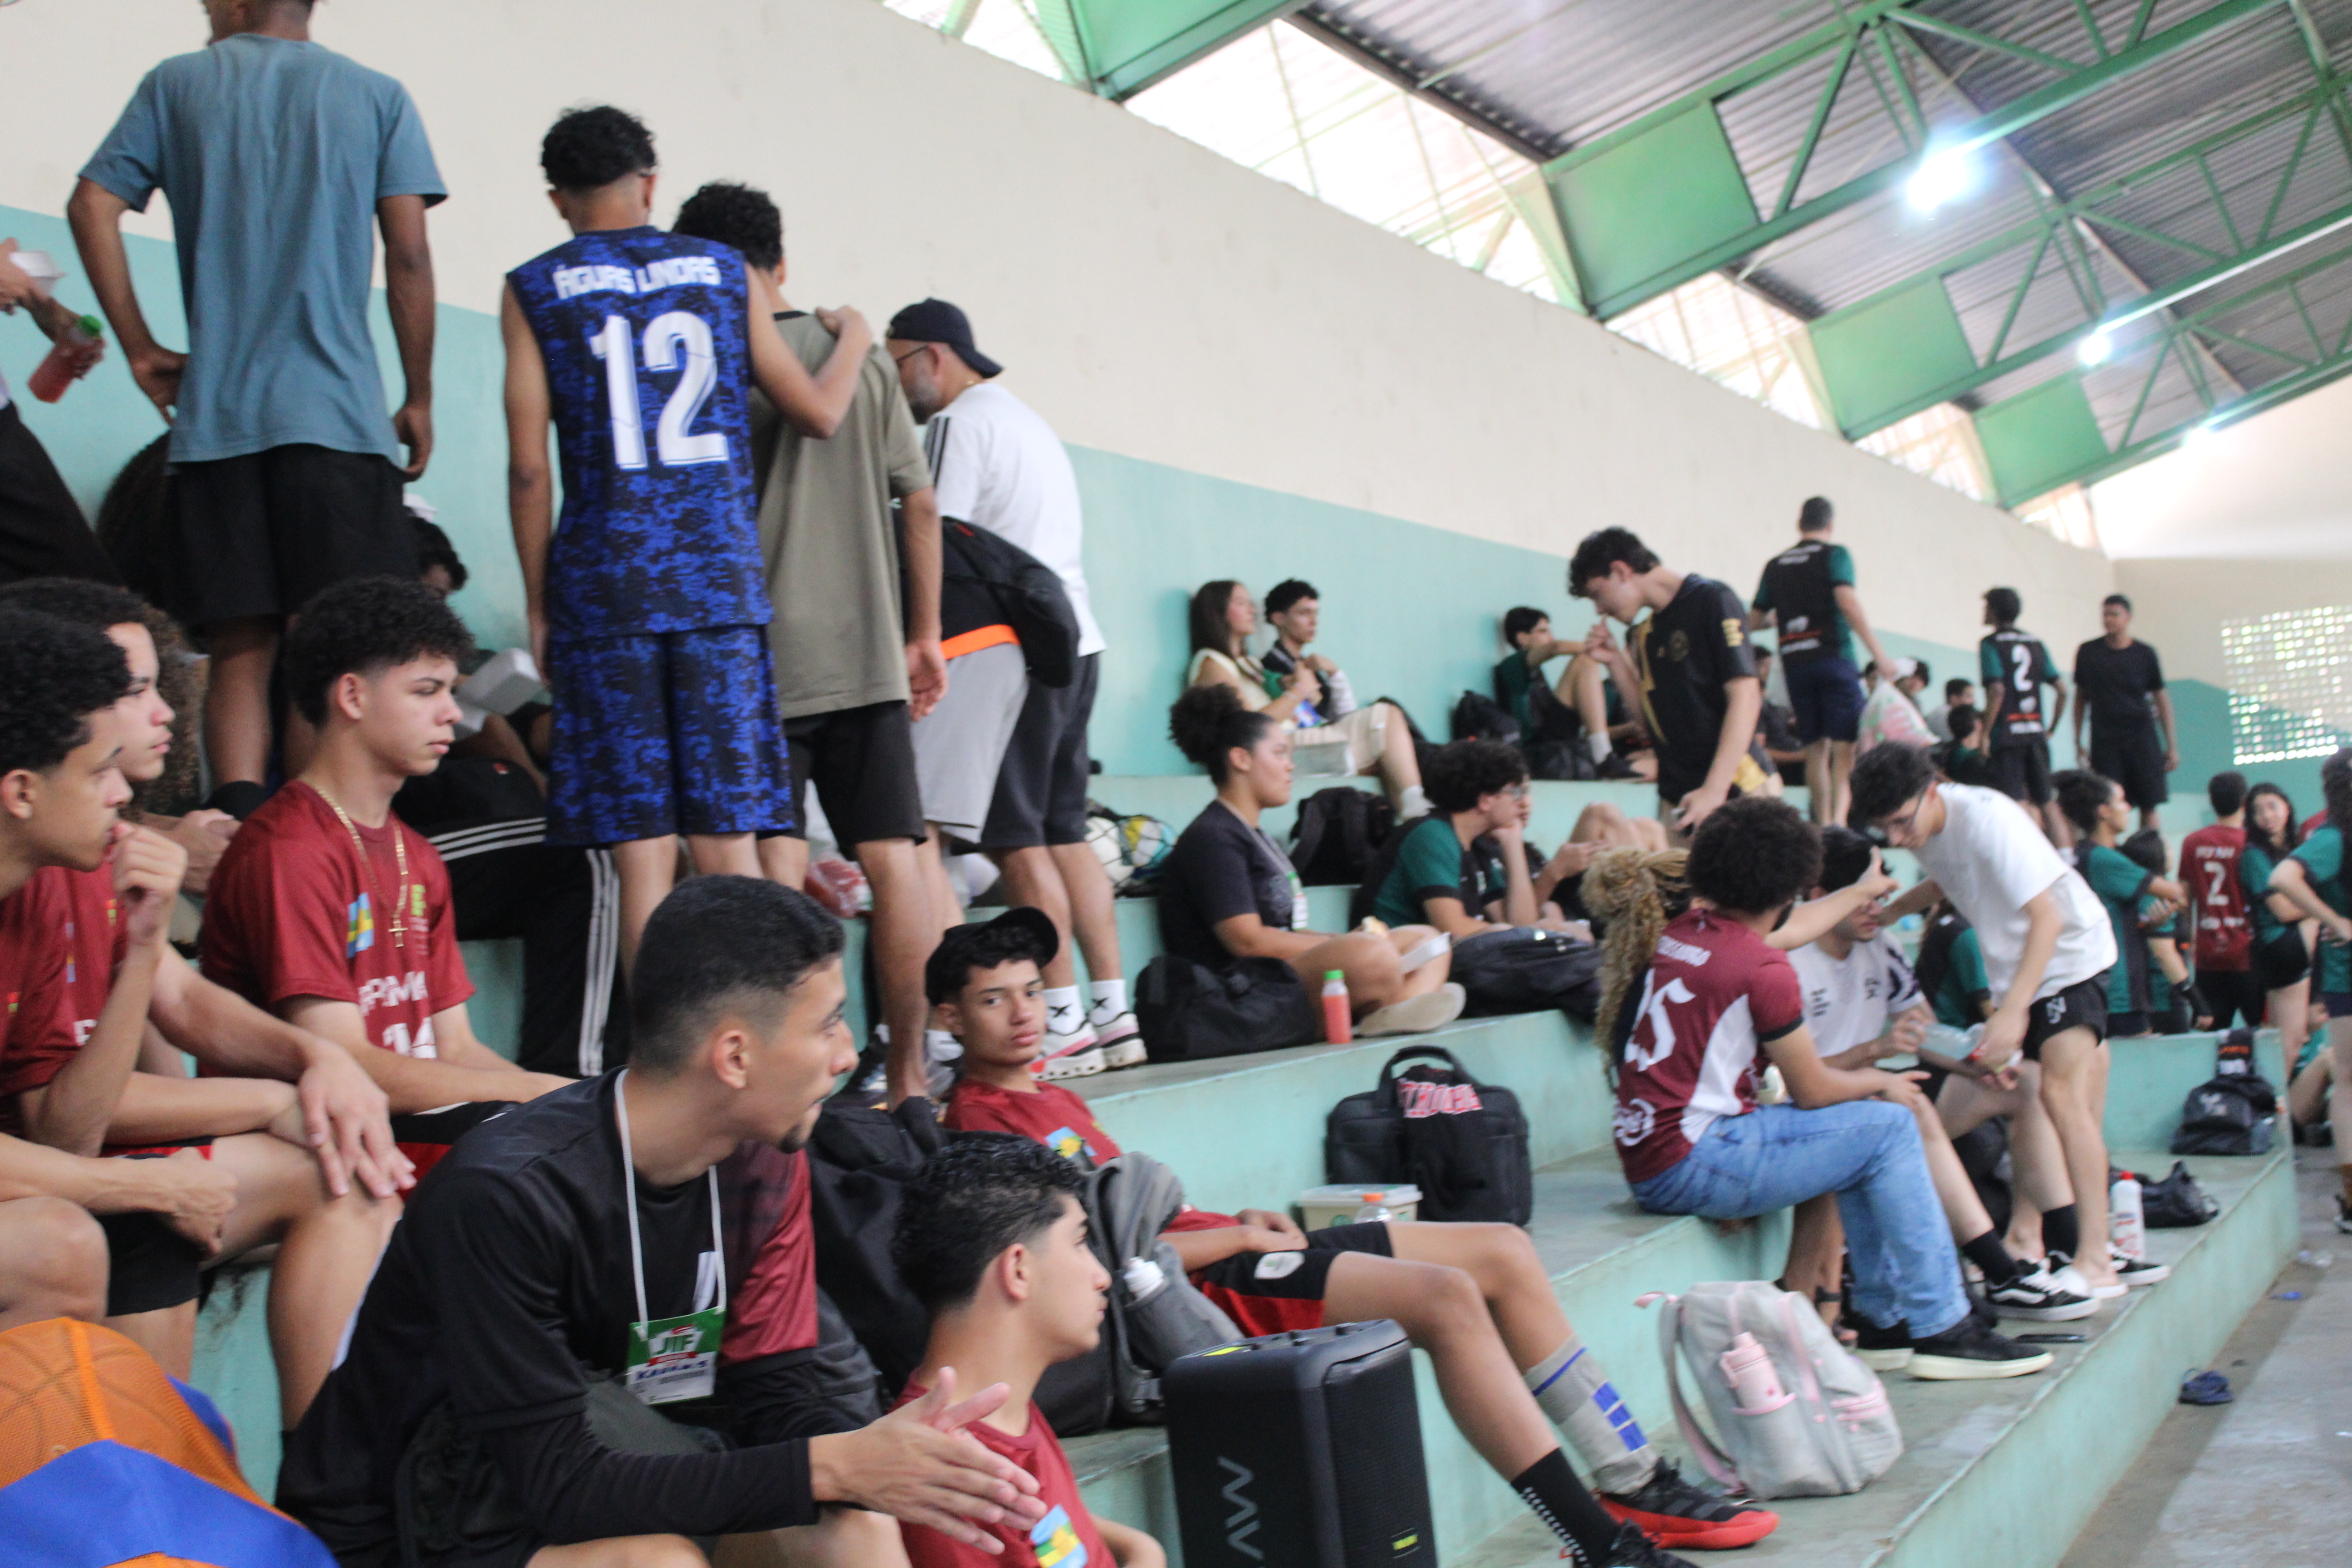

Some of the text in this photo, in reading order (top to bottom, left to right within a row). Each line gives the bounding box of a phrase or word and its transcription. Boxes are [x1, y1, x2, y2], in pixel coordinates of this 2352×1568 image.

[590, 311, 729, 469] 12
[2011, 643, 2034, 691] 2
[2204, 861, 2230, 906] 2
